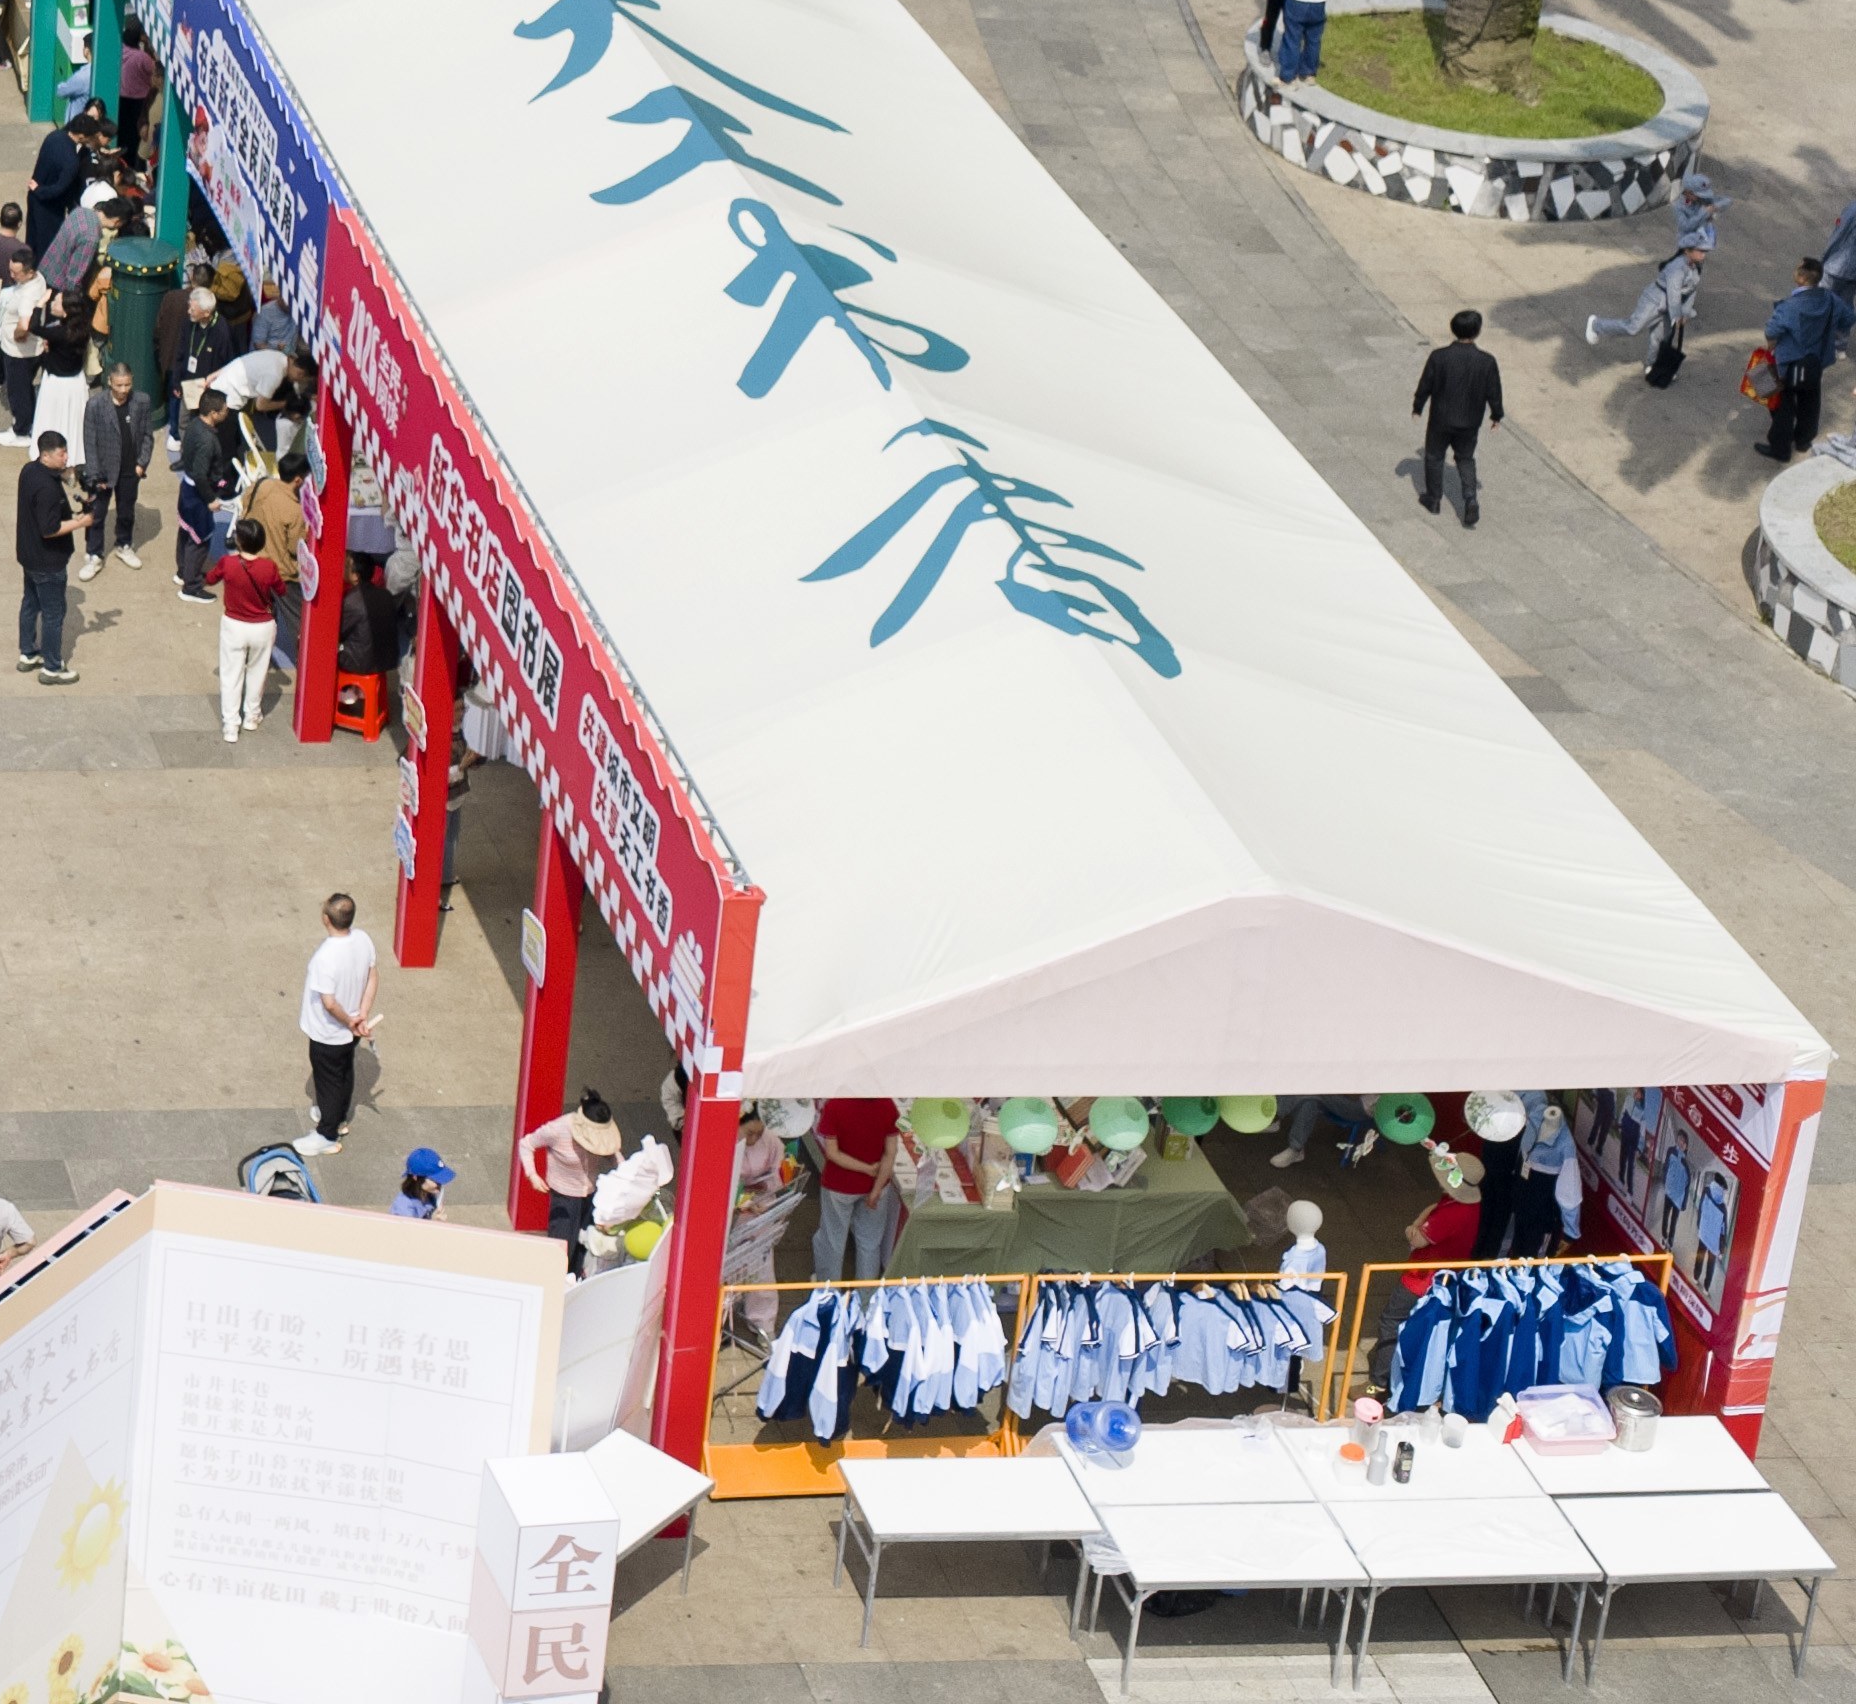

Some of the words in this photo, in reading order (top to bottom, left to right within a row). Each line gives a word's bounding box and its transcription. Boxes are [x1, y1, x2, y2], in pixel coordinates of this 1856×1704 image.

[348, 289, 380, 396] 2026
[429, 436, 561, 720] 新华书店图书展
[582, 704, 656, 859] 共建城市文明
[595, 779, 668, 936] 共享天工书香
[184, 1372, 270, 1399] 市井长巷
